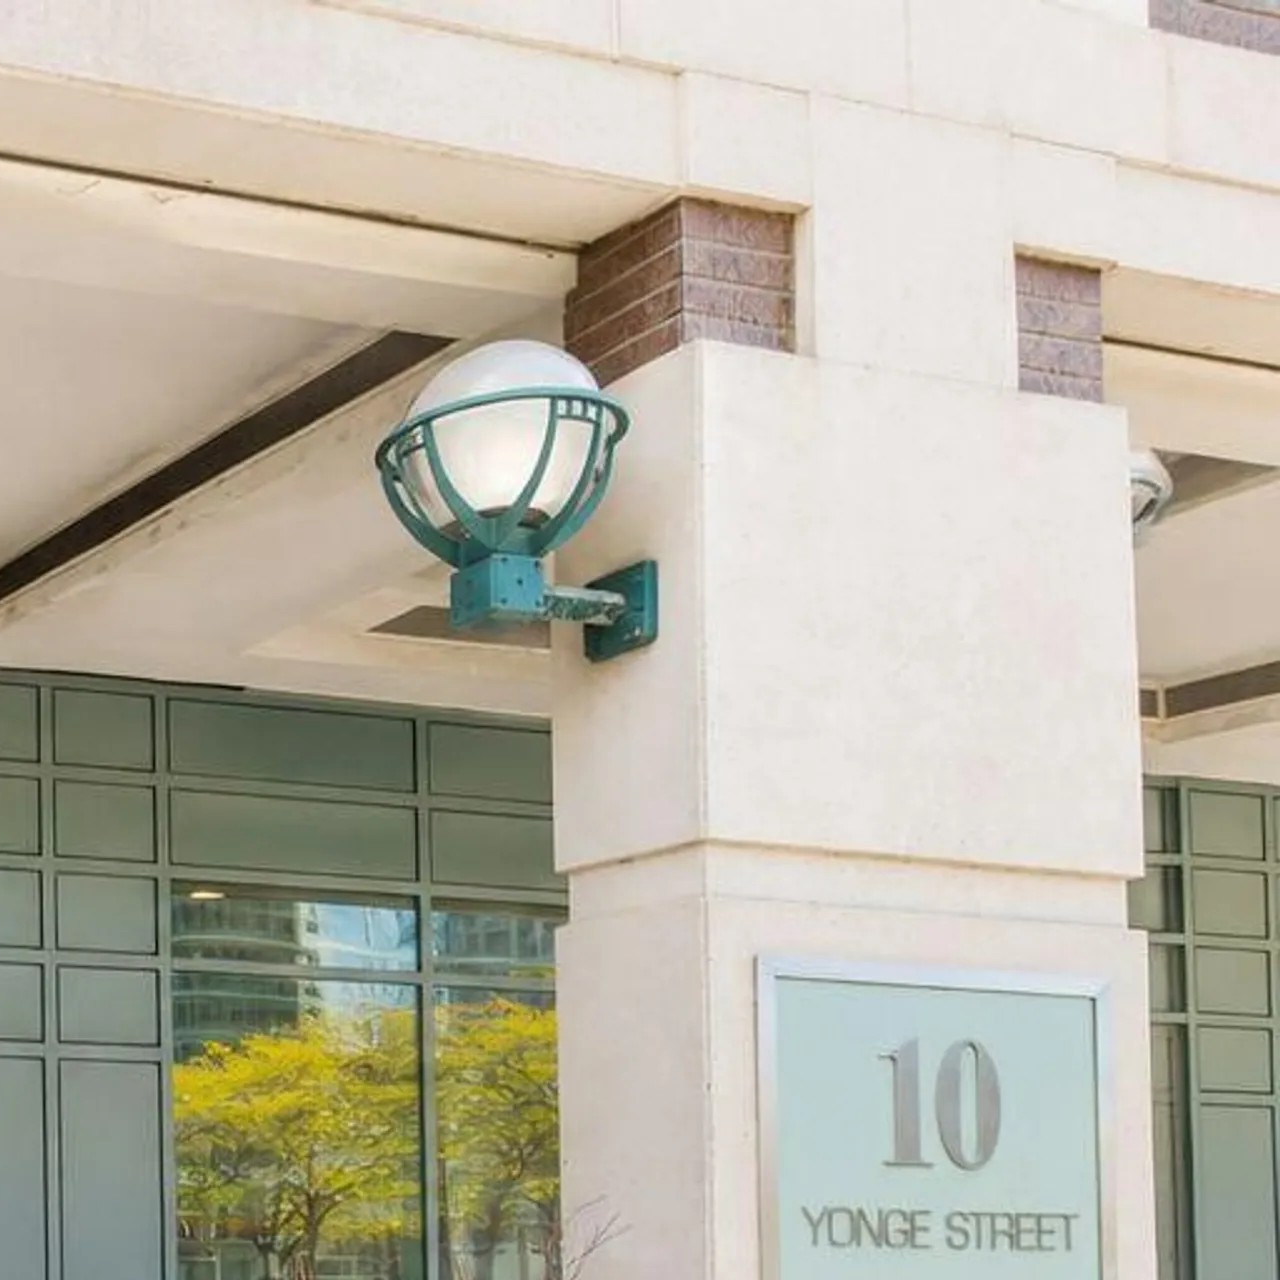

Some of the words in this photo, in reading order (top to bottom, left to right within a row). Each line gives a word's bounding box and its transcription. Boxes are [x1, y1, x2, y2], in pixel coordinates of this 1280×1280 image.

[877, 1036, 1002, 1171] 10
[801, 1206, 932, 1250] YONGE
[945, 1211, 1081, 1252] STREET
